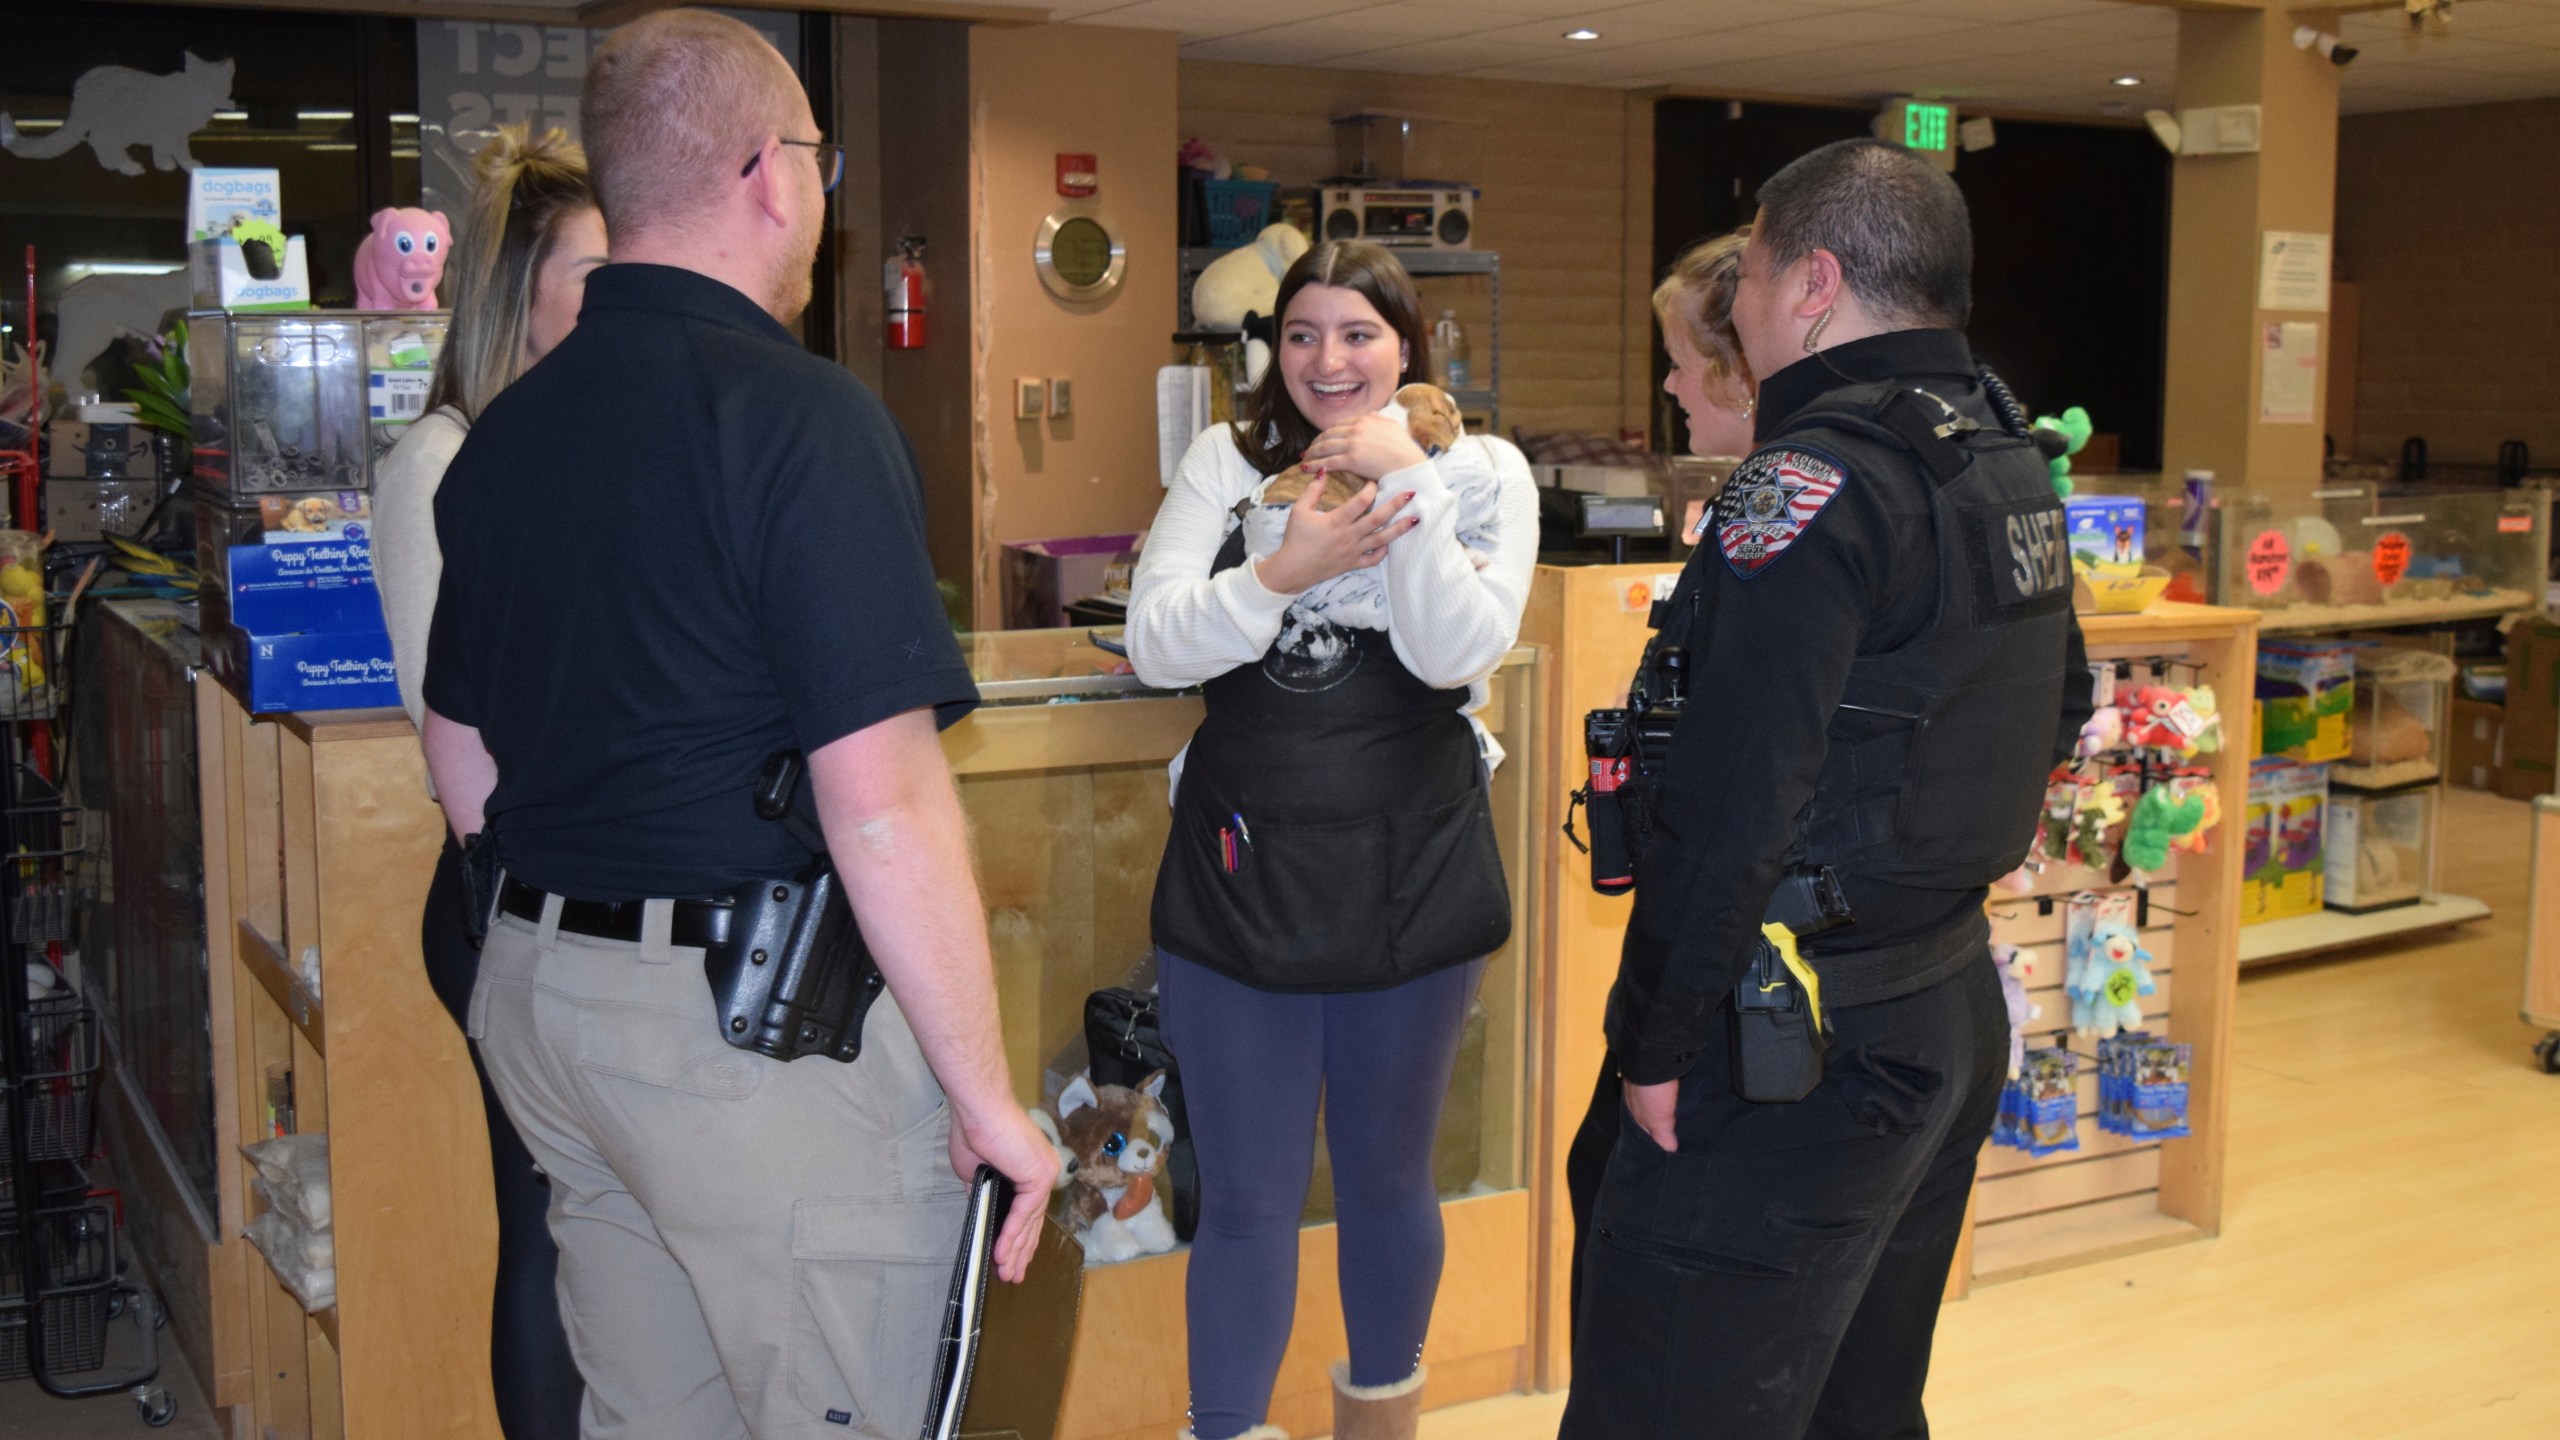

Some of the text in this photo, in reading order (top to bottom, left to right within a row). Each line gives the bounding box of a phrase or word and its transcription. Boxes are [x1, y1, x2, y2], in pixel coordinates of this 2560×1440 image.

[1905, 103, 1949, 151] EXIT
[203, 180, 271, 196] dogbags
[236, 285, 298, 299] dogbags
[1791, 452, 1840, 478] COUNTY
[1735, 552, 1768, 560] SHERIFF
[1737, 543, 1768, 553] DEPUTY
[272, 549, 307, 567] Puppy
[306, 546, 350, 564] Teething
[297, 661, 330, 678] Puppy
[329, 658, 371, 676] Teething
[1645, 730, 1672, 738] MOTOROL
